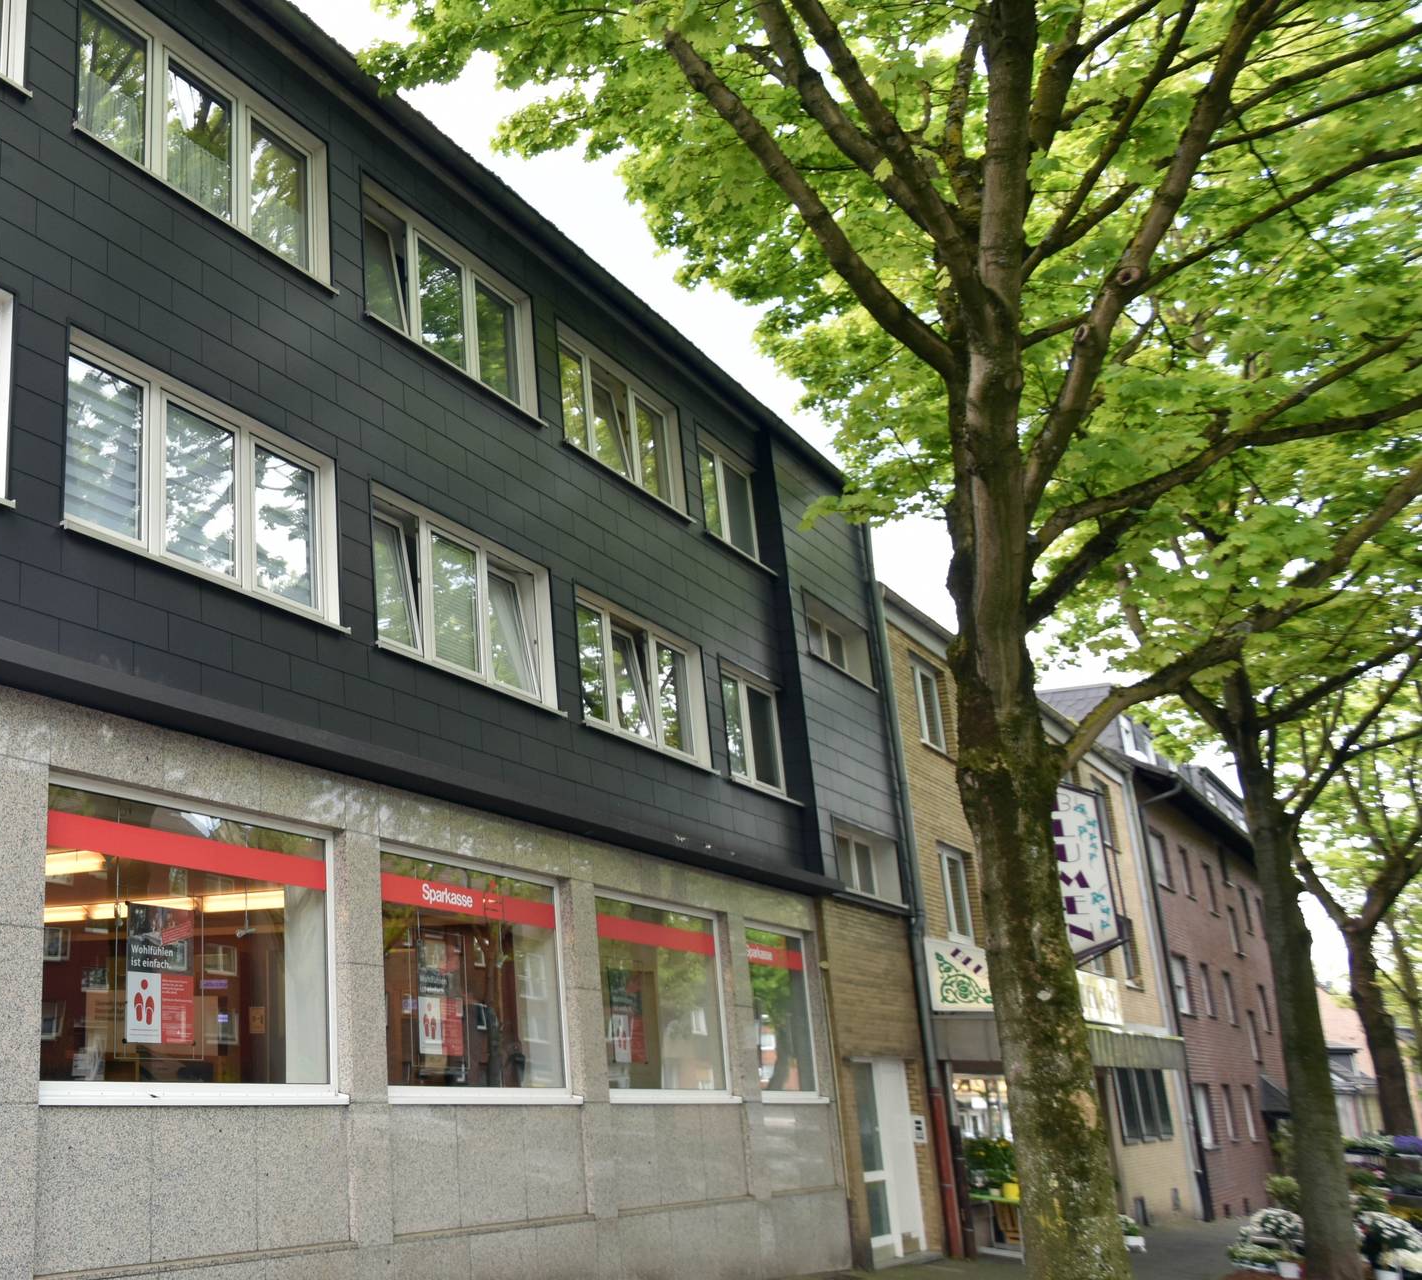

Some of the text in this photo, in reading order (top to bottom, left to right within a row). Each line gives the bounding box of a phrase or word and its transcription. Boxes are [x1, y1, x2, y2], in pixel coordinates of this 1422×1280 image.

[422, 883, 474, 908] Sparkasse
[131, 944, 174, 957] Wohlfühlen
[131, 959, 172, 969] ist einfach.
